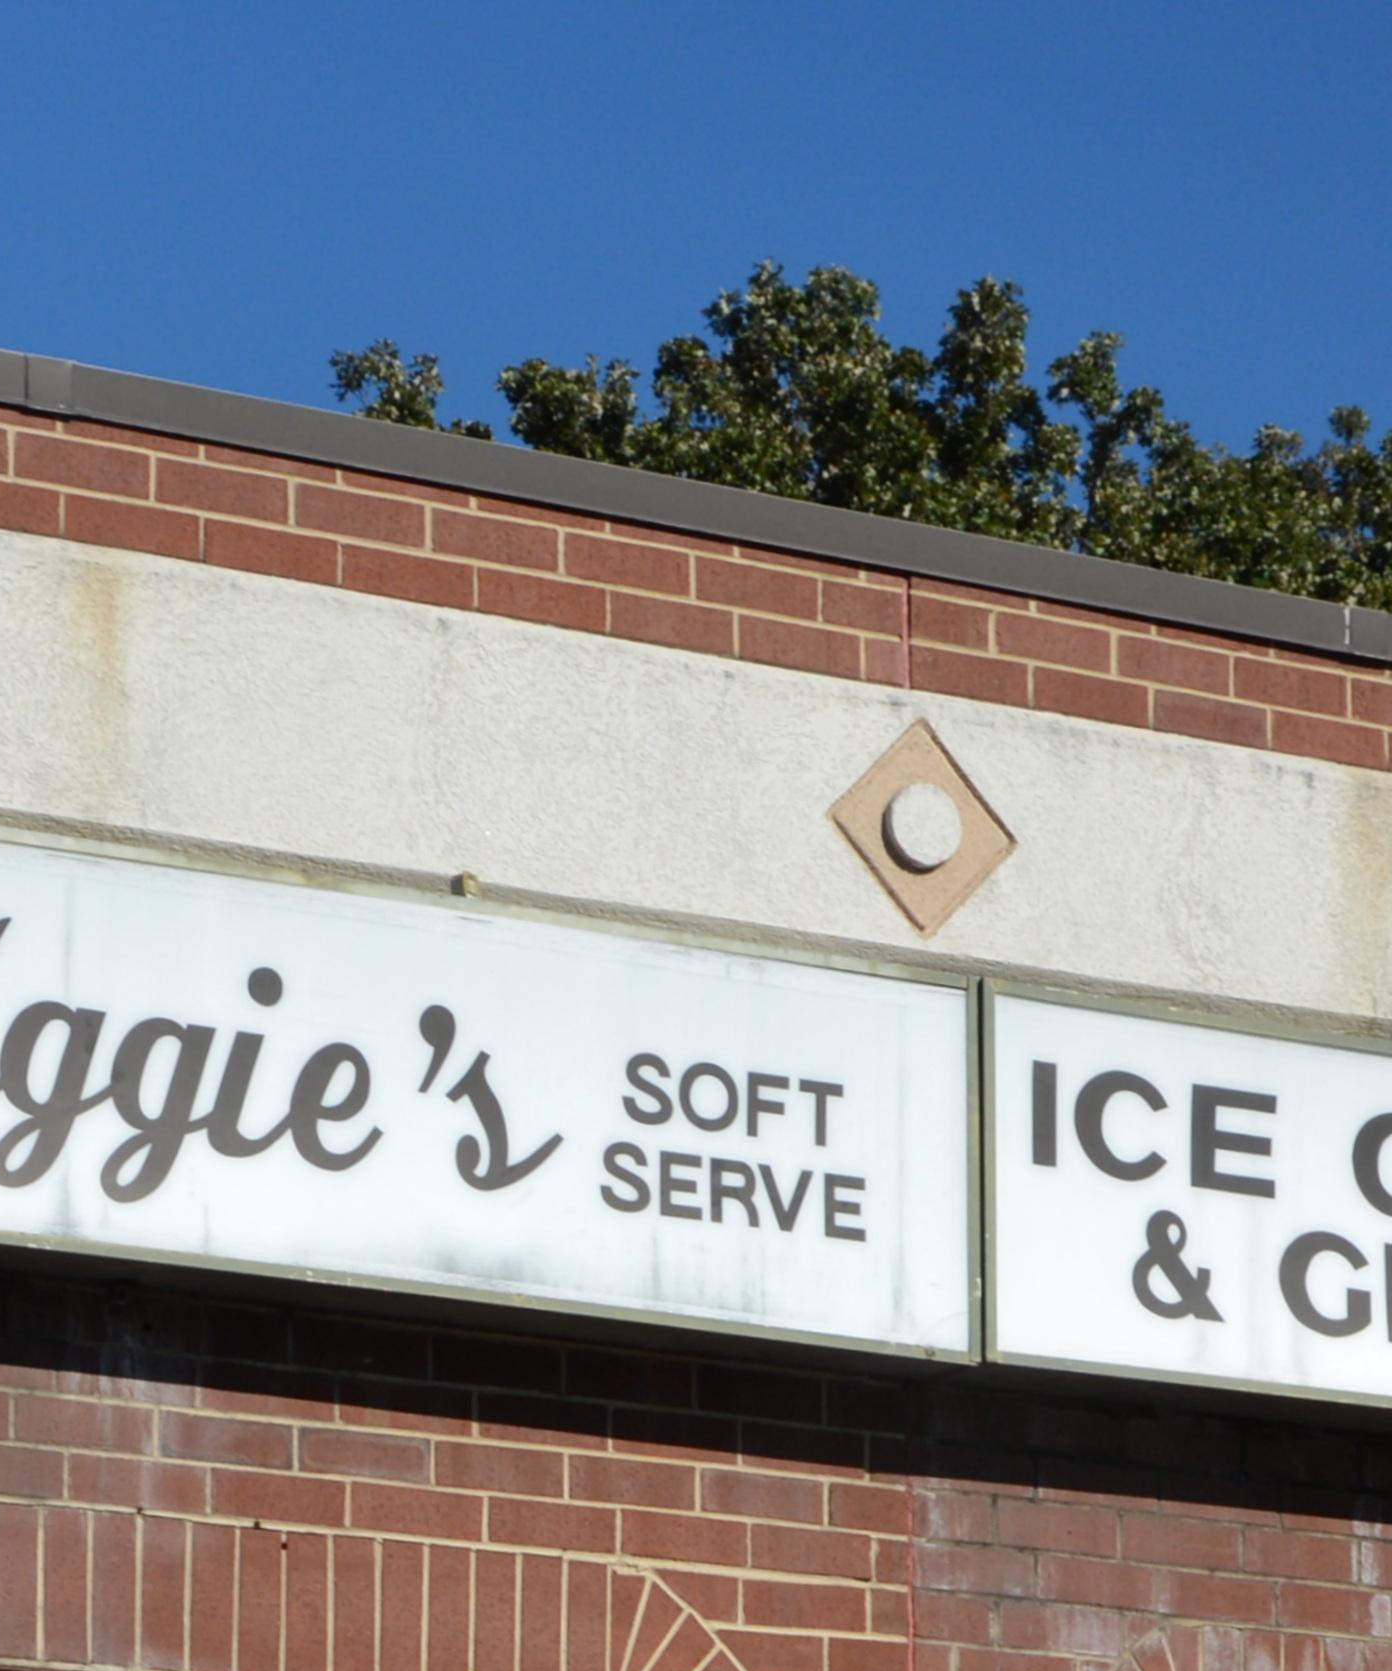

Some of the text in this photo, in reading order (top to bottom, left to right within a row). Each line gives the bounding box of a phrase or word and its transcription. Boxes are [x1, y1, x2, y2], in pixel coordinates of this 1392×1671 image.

[621, 1052, 844, 1147] SOFT
[1032, 1060, 1278, 1199] ICE
[600, 1141, 866, 1242] SERVE
[1132, 1210, 1224, 1323] &
